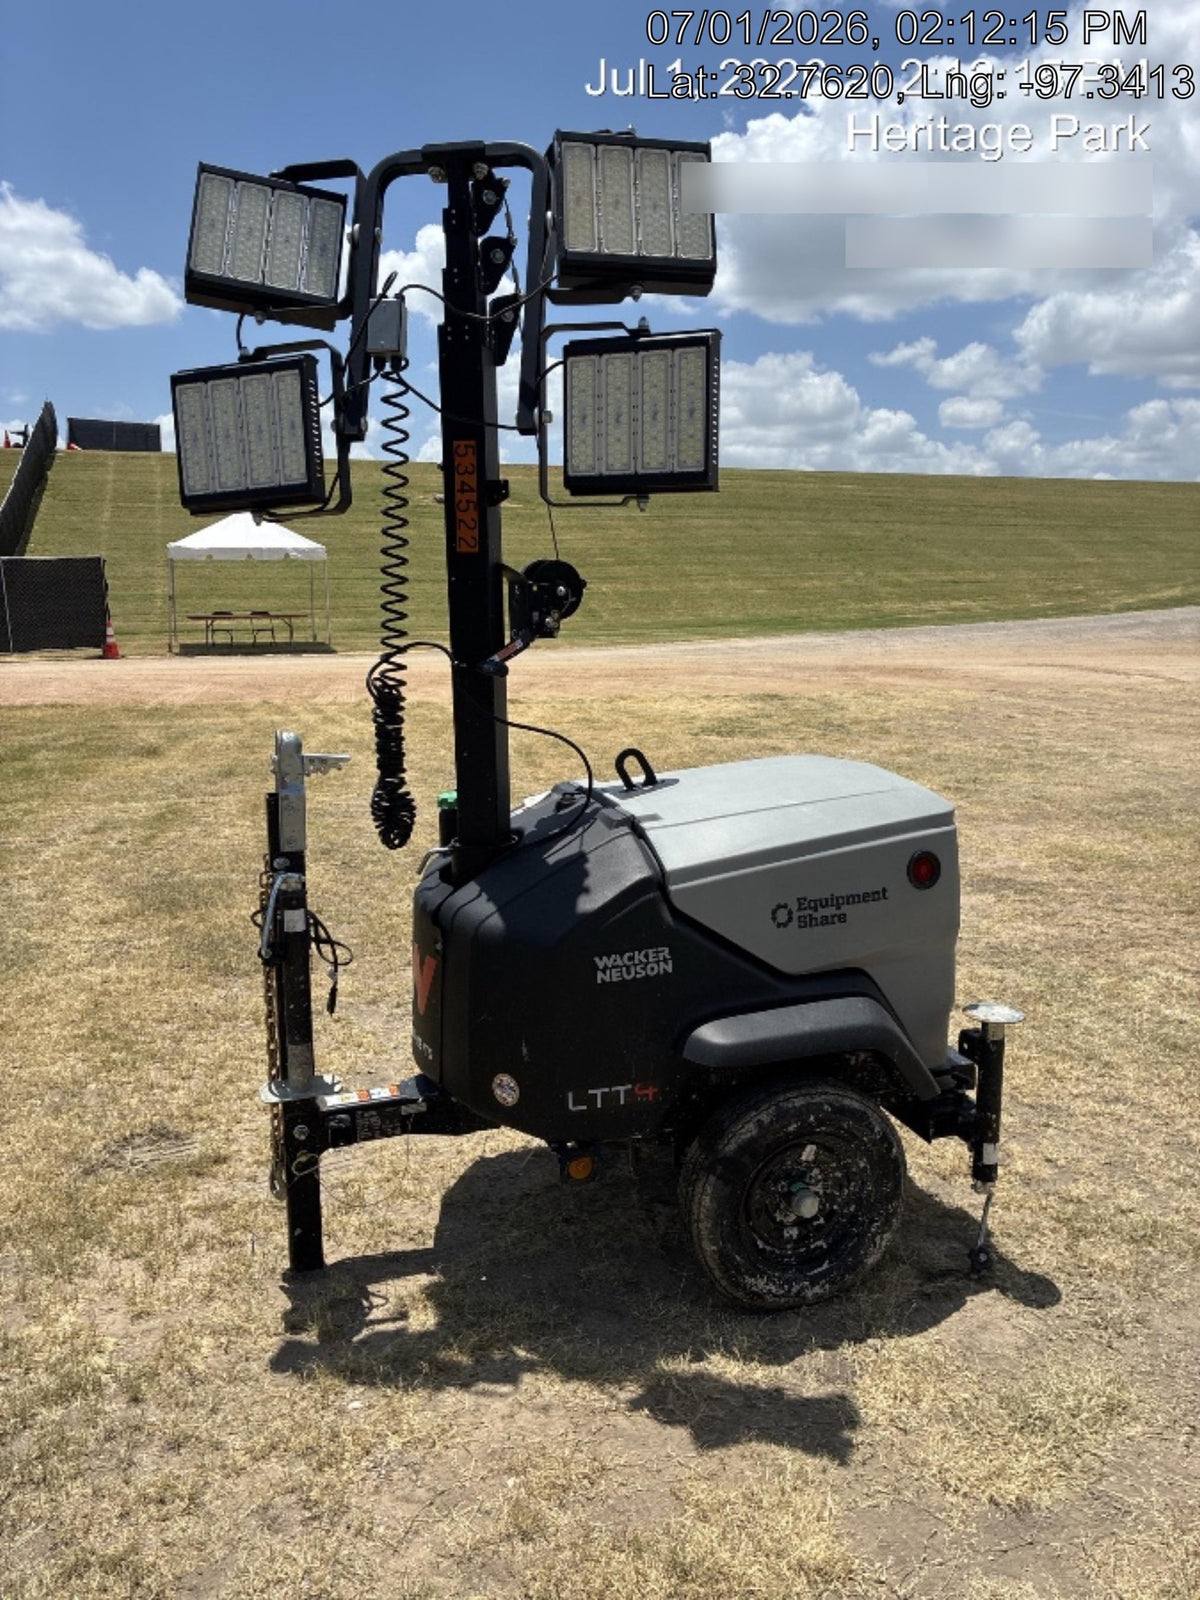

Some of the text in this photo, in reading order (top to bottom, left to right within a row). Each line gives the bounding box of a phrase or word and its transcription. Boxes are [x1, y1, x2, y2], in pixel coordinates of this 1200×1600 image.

[455, 443, 477, 549] 534522
[796, 886, 888, 912] Equipment
[797, 911, 848, 929] Share
[594, 946, 671, 970] WACKER
[596, 959, 673, 984] NEUSON
